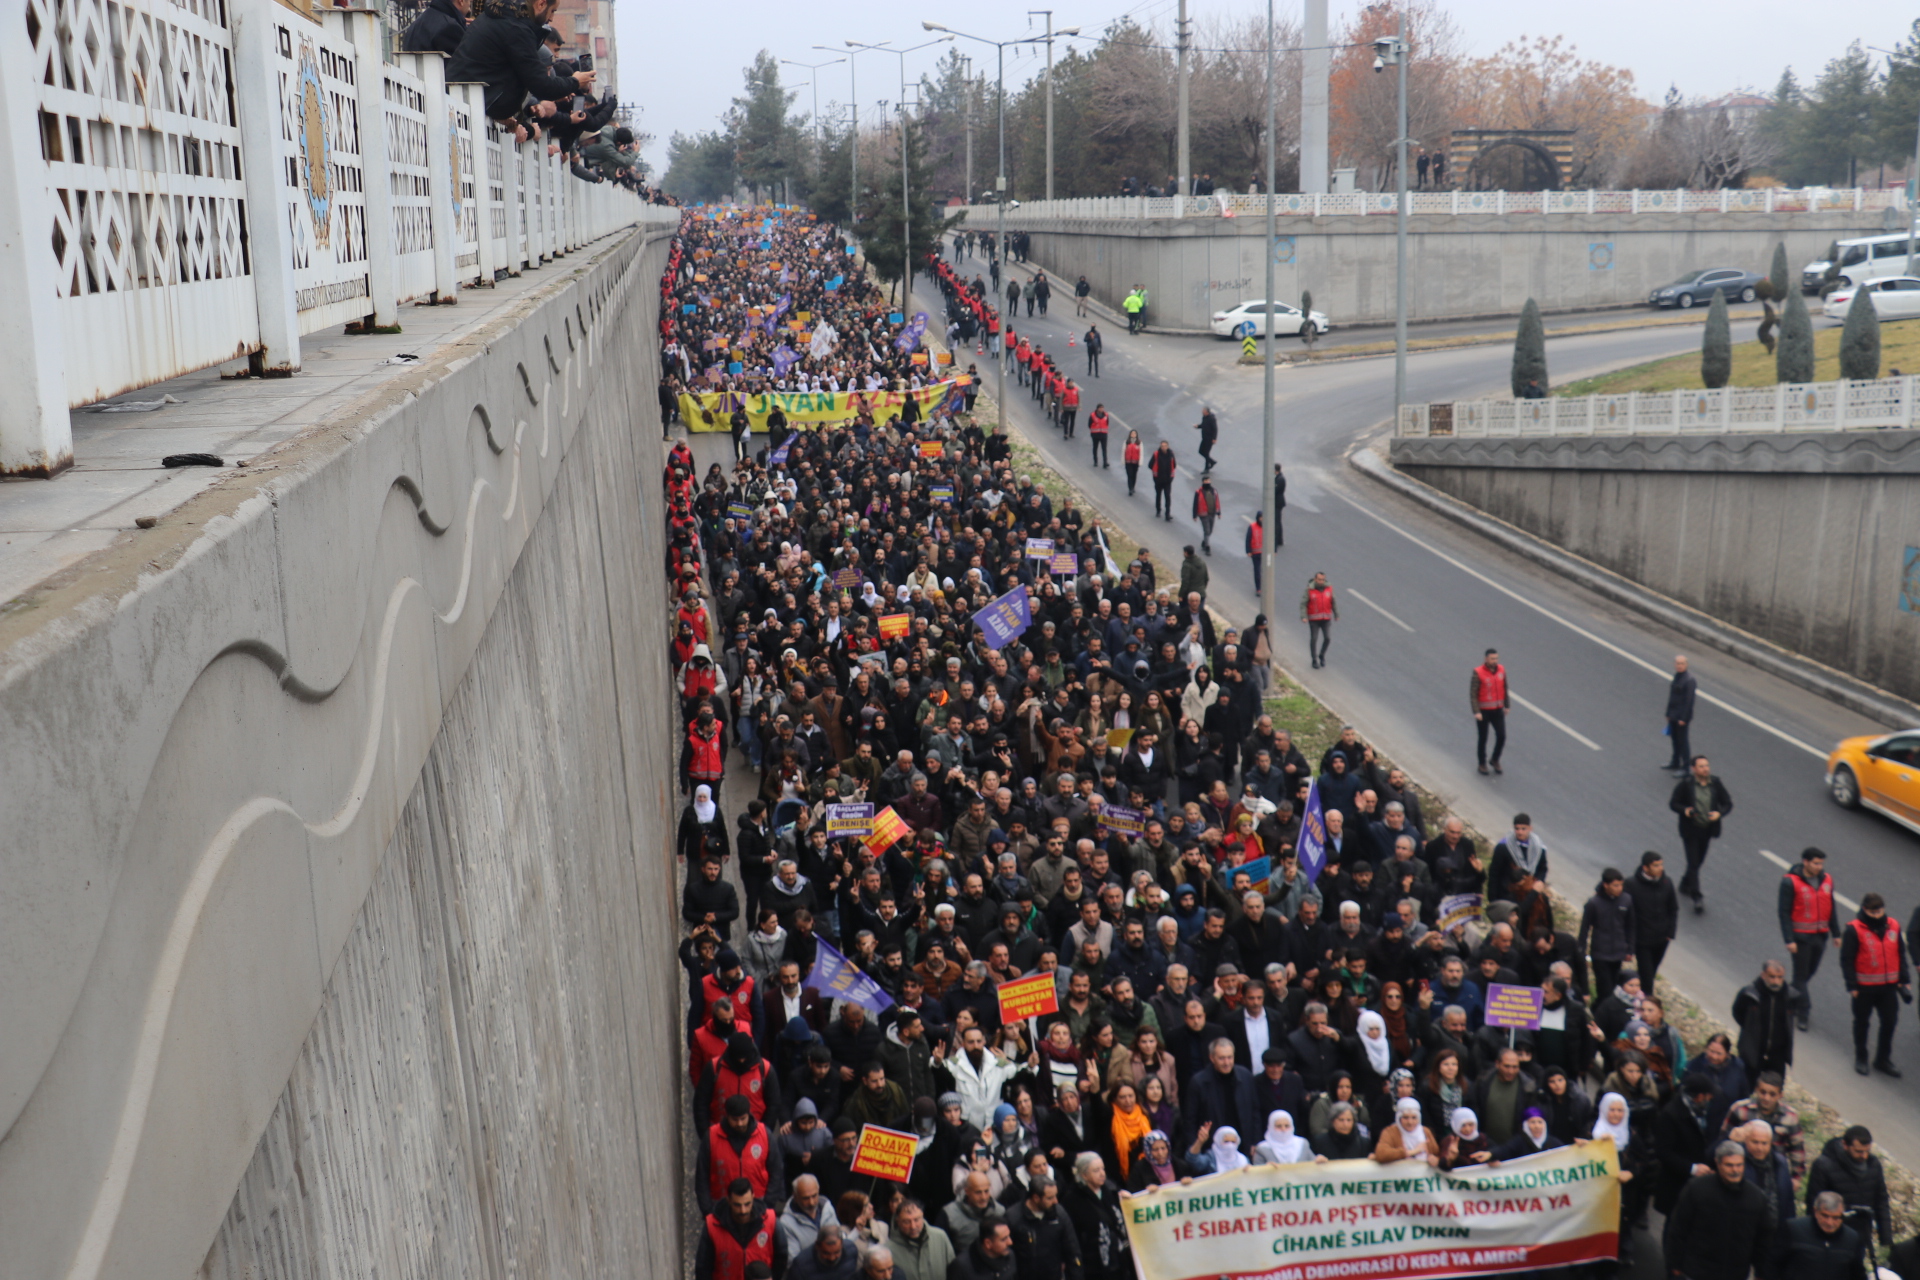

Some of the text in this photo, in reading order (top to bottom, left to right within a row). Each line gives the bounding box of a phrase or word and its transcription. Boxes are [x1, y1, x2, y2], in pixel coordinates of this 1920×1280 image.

[295, 288, 311, 313] BAKIR
[713, 392, 746, 414] JIN
[756, 392, 835, 414] JIYAN
[997, 602, 1022, 629] JIYAN
[831, 820, 870, 829] DİRENİŞE
[1002, 989, 1053, 1010] KURDISTAN
[1016, 1004, 1034, 1017] YEK
[864, 1133, 911, 1154] ROJAVA
[1133, 1205, 1161, 1224] EM
[1166, 1199, 1183, 1217] BI
[1189, 1187, 1244, 1213] RUHÊ
[1445, 1178, 1471, 1192] YA
[1477, 1160, 1608, 1192] DEMOKRATÎK
[1172, 1222, 1194, 1242] 1Ê
[1199, 1212, 1268, 1238] SIBATÊ
[1272, 1209, 1323, 1229] ROJA
[1464, 1197, 1543, 1217] ROJAVA
[1548, 1194, 1572, 1210] YA
[1273, 1225, 1470, 1255] CÎHANÊ SILAV DIKIN
[1410, 1251, 1449, 1269] KEDÊ
[1451, 1252, 1471, 1266] YA
[1473, 1247, 1528, 1265] AMEDÊ
